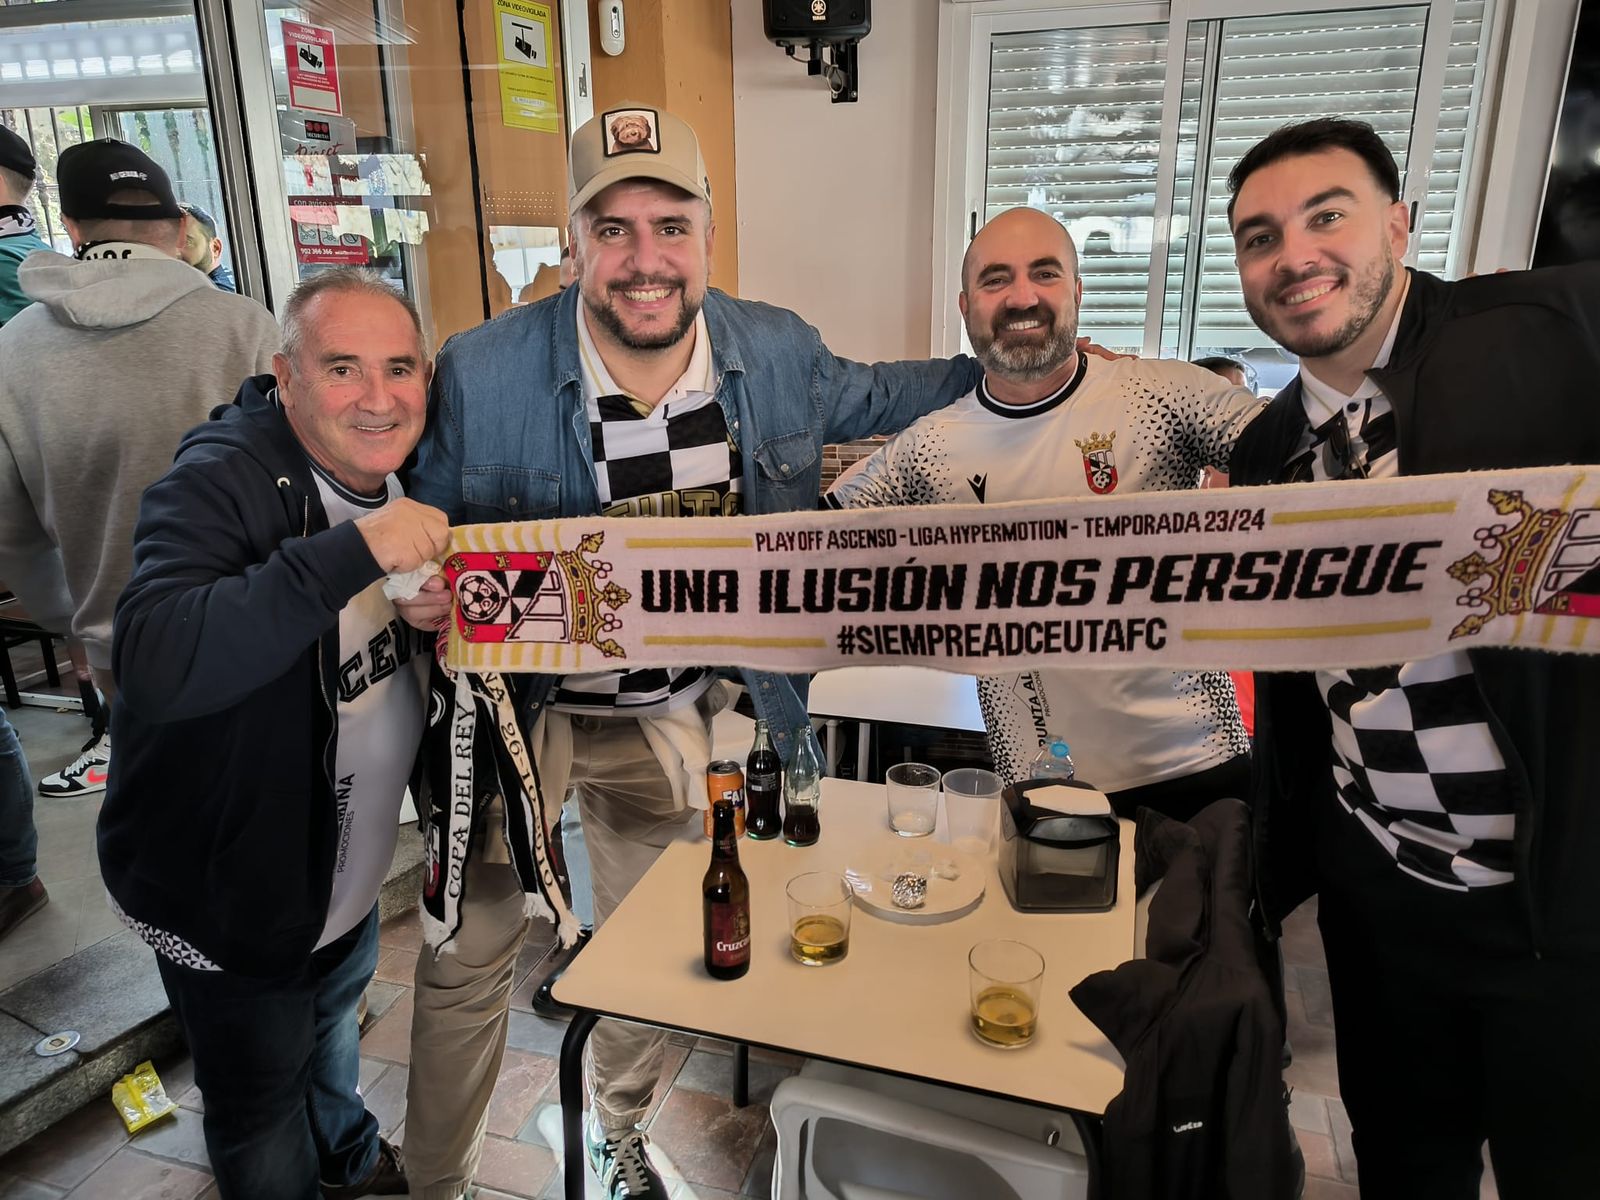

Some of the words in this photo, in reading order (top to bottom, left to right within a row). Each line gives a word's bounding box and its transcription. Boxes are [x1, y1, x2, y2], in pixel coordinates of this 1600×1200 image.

[301, 27, 316, 35] ZONA
[497, 0, 512, 8] ZONA
[512, 3, 547, 17] VIDEOVIGILADA
[288, 31, 329, 45] VIDEOVIGILADA
[756, 532, 796, 552] PLAY
[798, 531, 823, 550] OFF
[826, 528, 897, 550] ASCENSO
[909, 526, 948, 546] LIGA
[950, 518, 1068, 545] HYPERMOTION
[1084, 511, 1201, 539] TEMPORADA
[1204, 508, 1266, 532] 23/24
[641, 569, 739, 613] UNA
[759, 557, 967, 614] ILUSIÓN
[975, 558, 1102, 610] NOS
[1107, 540, 1443, 604] PERSIGUE
[837, 617, 1167, 657] #SIEMPREADCEUTAFC
[455, 702, 476, 760] REY
[1029, 695, 1048, 748] PUNTA
[454, 766, 473, 818] DEL
[337, 810, 355, 873] PROMOCIONES
[448, 825, 469, 899] COPA
